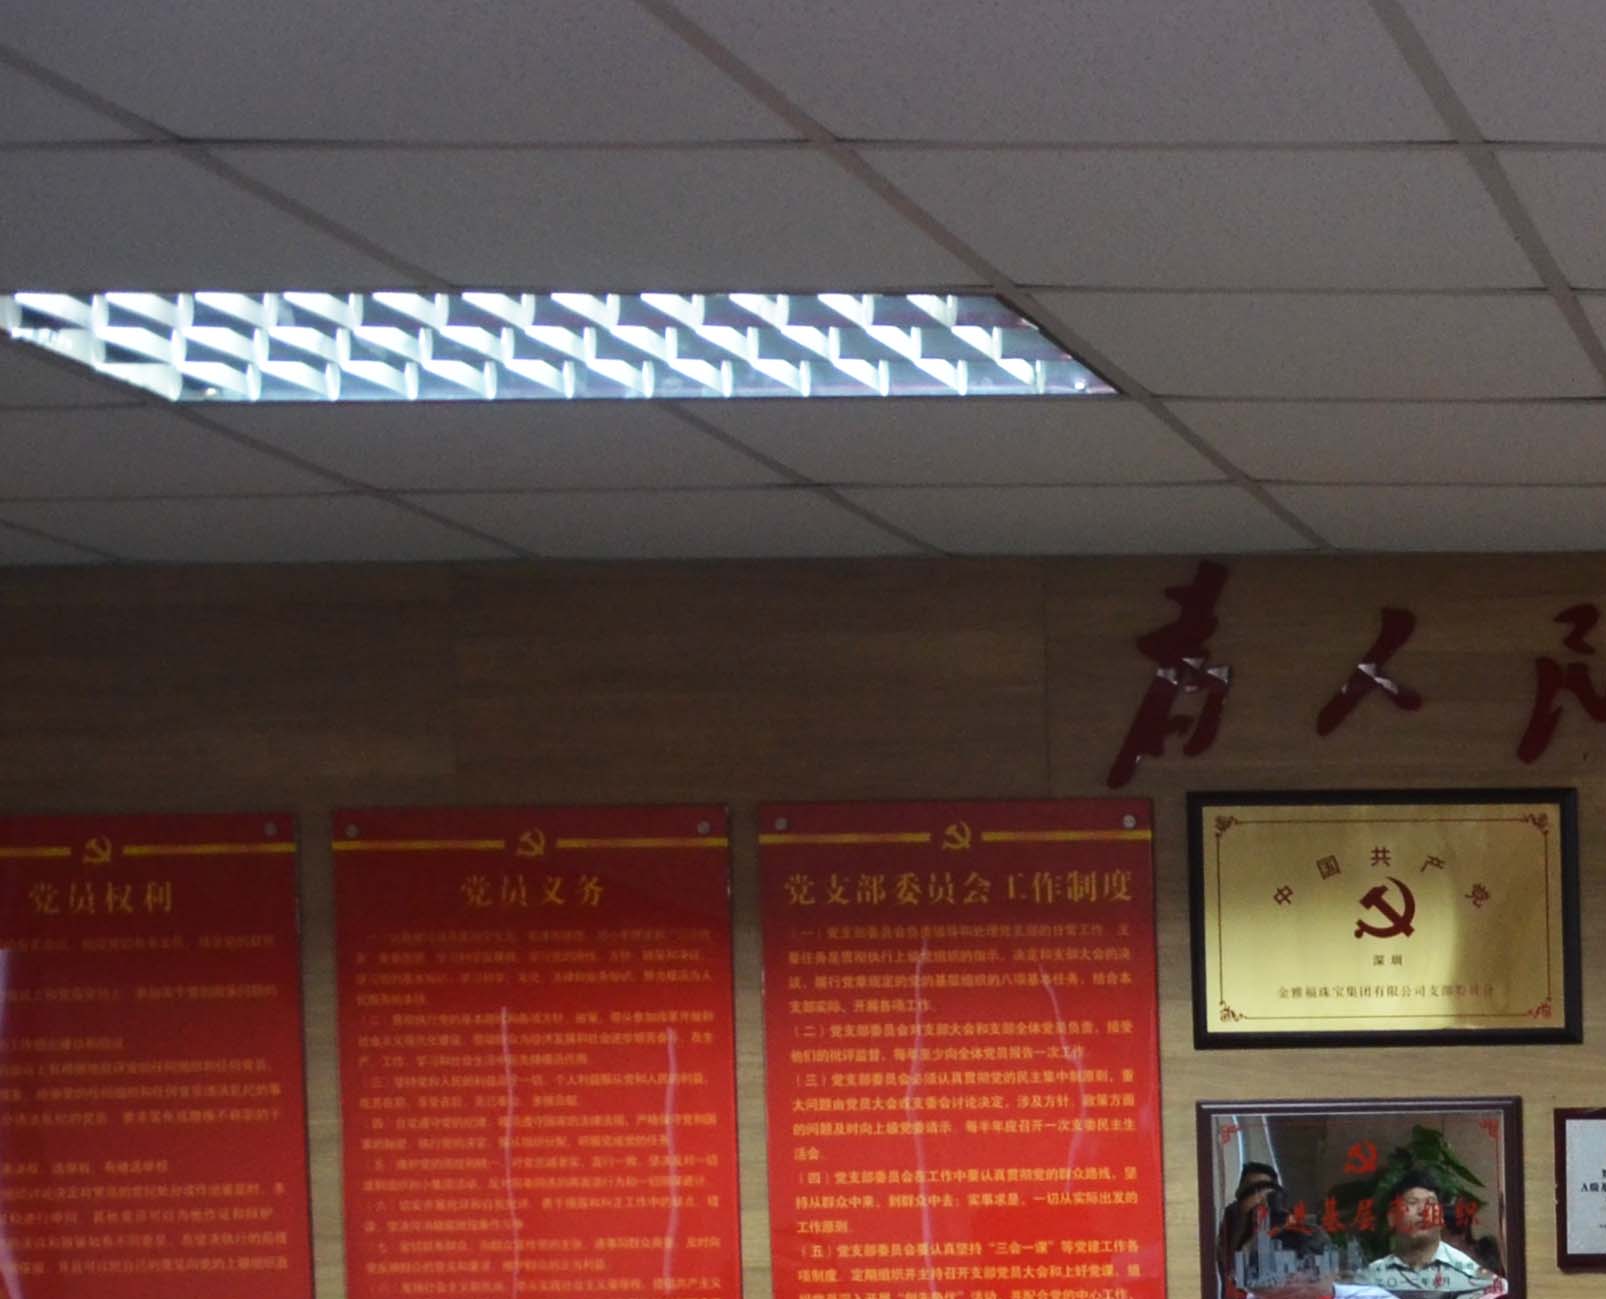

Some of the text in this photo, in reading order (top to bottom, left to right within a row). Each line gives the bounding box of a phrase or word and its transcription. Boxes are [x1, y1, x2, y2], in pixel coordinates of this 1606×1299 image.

[459, 874, 606, 907] 党员义务
[785, 870, 1133, 905] 党支部委员会工作制度
[1274, 846, 1490, 909] 中国共产党
[28, 881, 173, 914] 党员权利
[1373, 955, 1403, 966] 深圳
